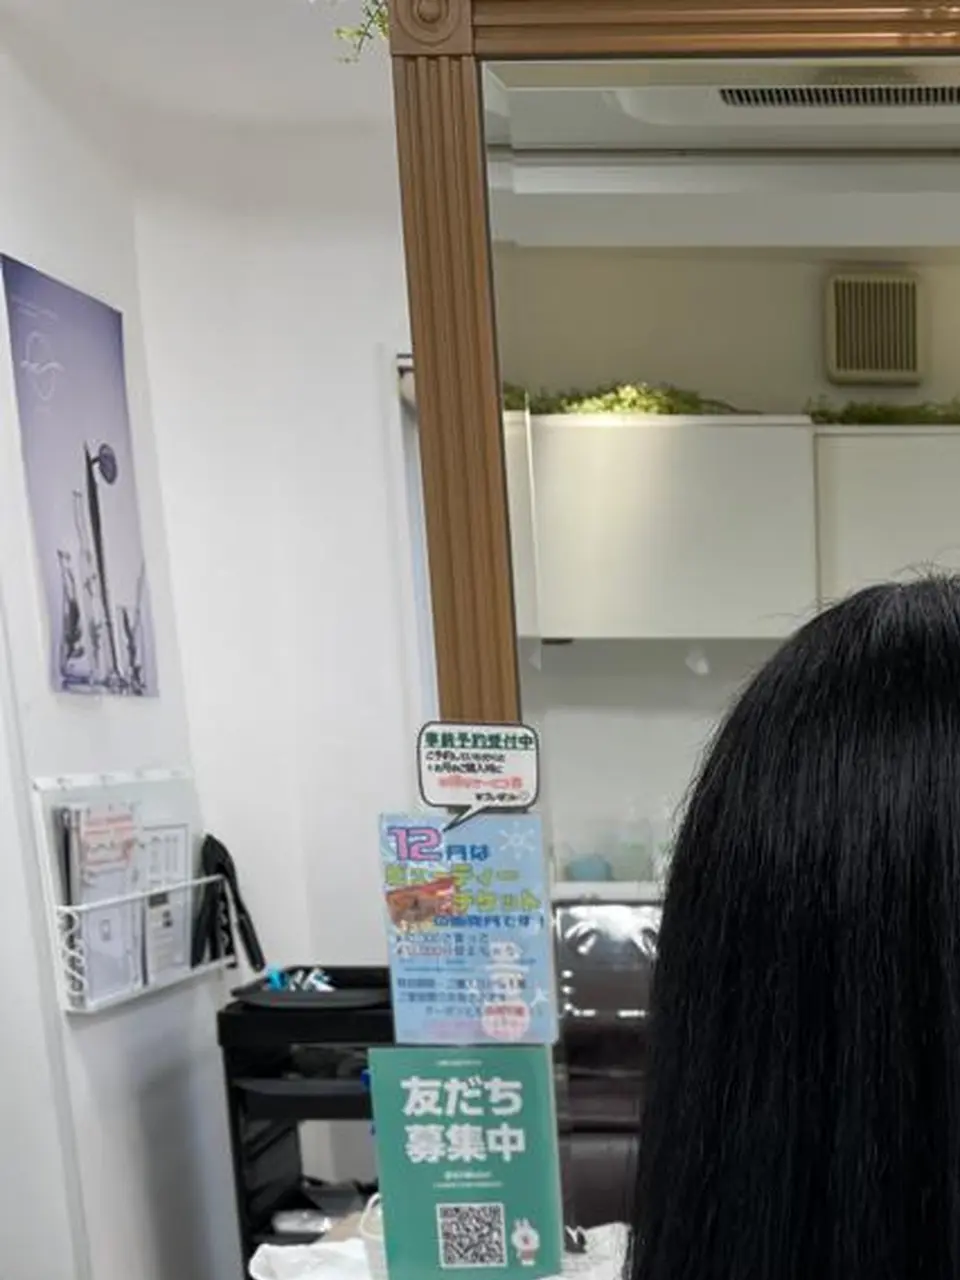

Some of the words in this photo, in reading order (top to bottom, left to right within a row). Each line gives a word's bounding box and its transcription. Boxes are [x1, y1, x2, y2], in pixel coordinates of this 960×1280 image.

[401, 1074, 524, 1118] 友だち
[404, 1122, 527, 1164] 募集中
